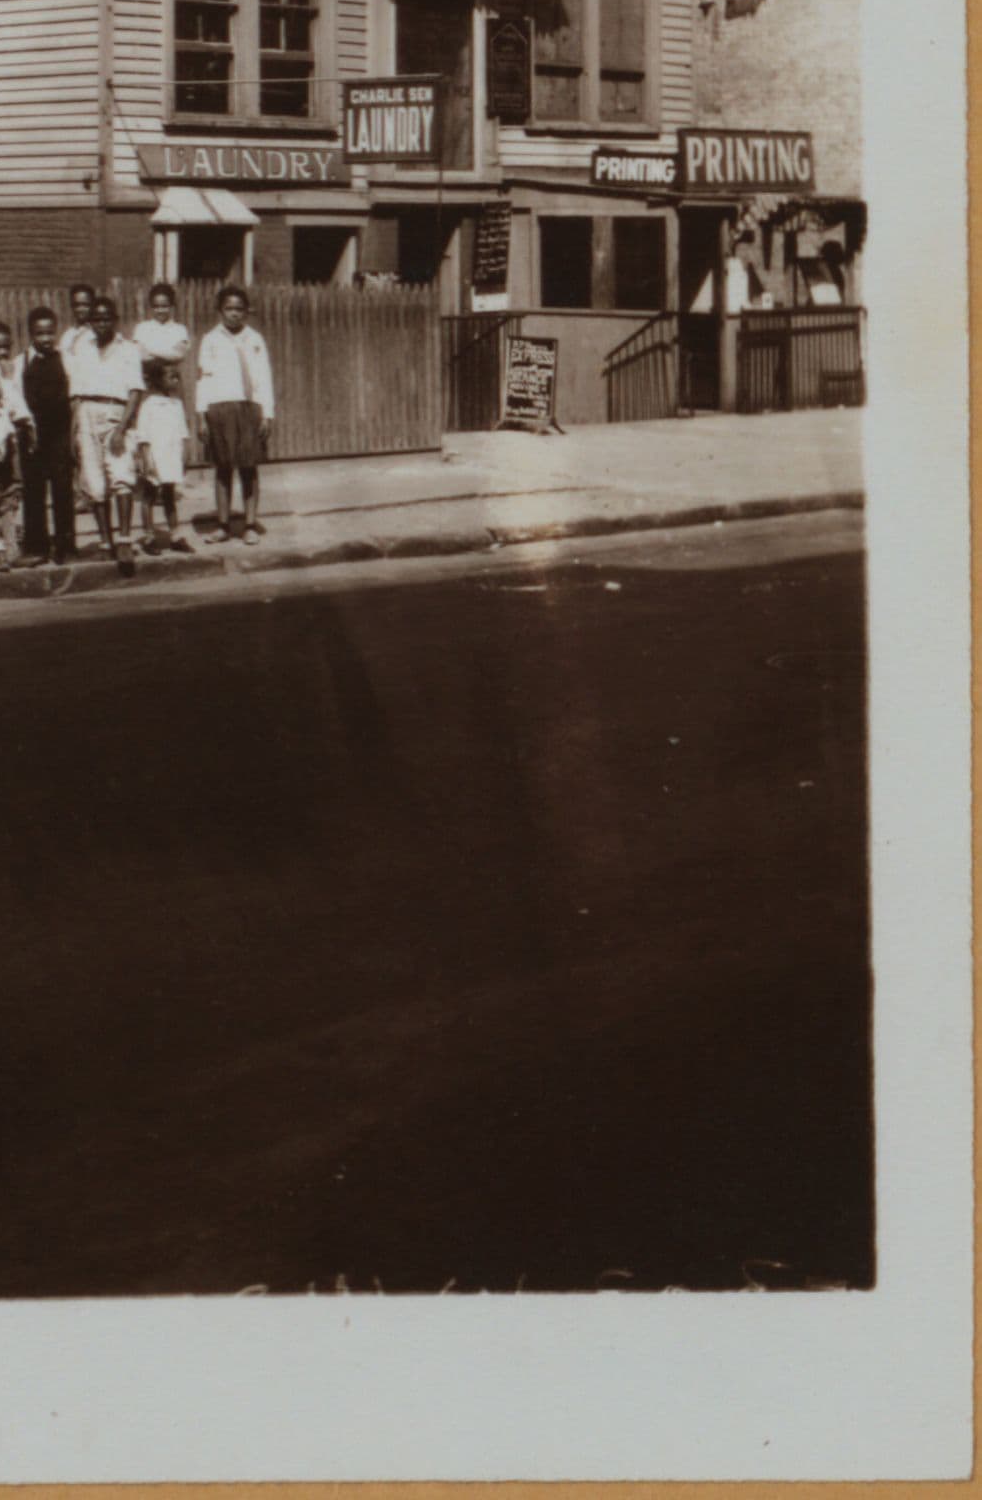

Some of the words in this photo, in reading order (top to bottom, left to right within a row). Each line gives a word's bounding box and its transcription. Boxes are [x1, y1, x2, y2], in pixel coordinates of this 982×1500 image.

[350, 88, 405, 104] CHARLIE
[347, 105, 434, 153] LAUNDRY
[595, 156, 675, 183] PRINTING
[686, 136, 811, 183] PRINTING
